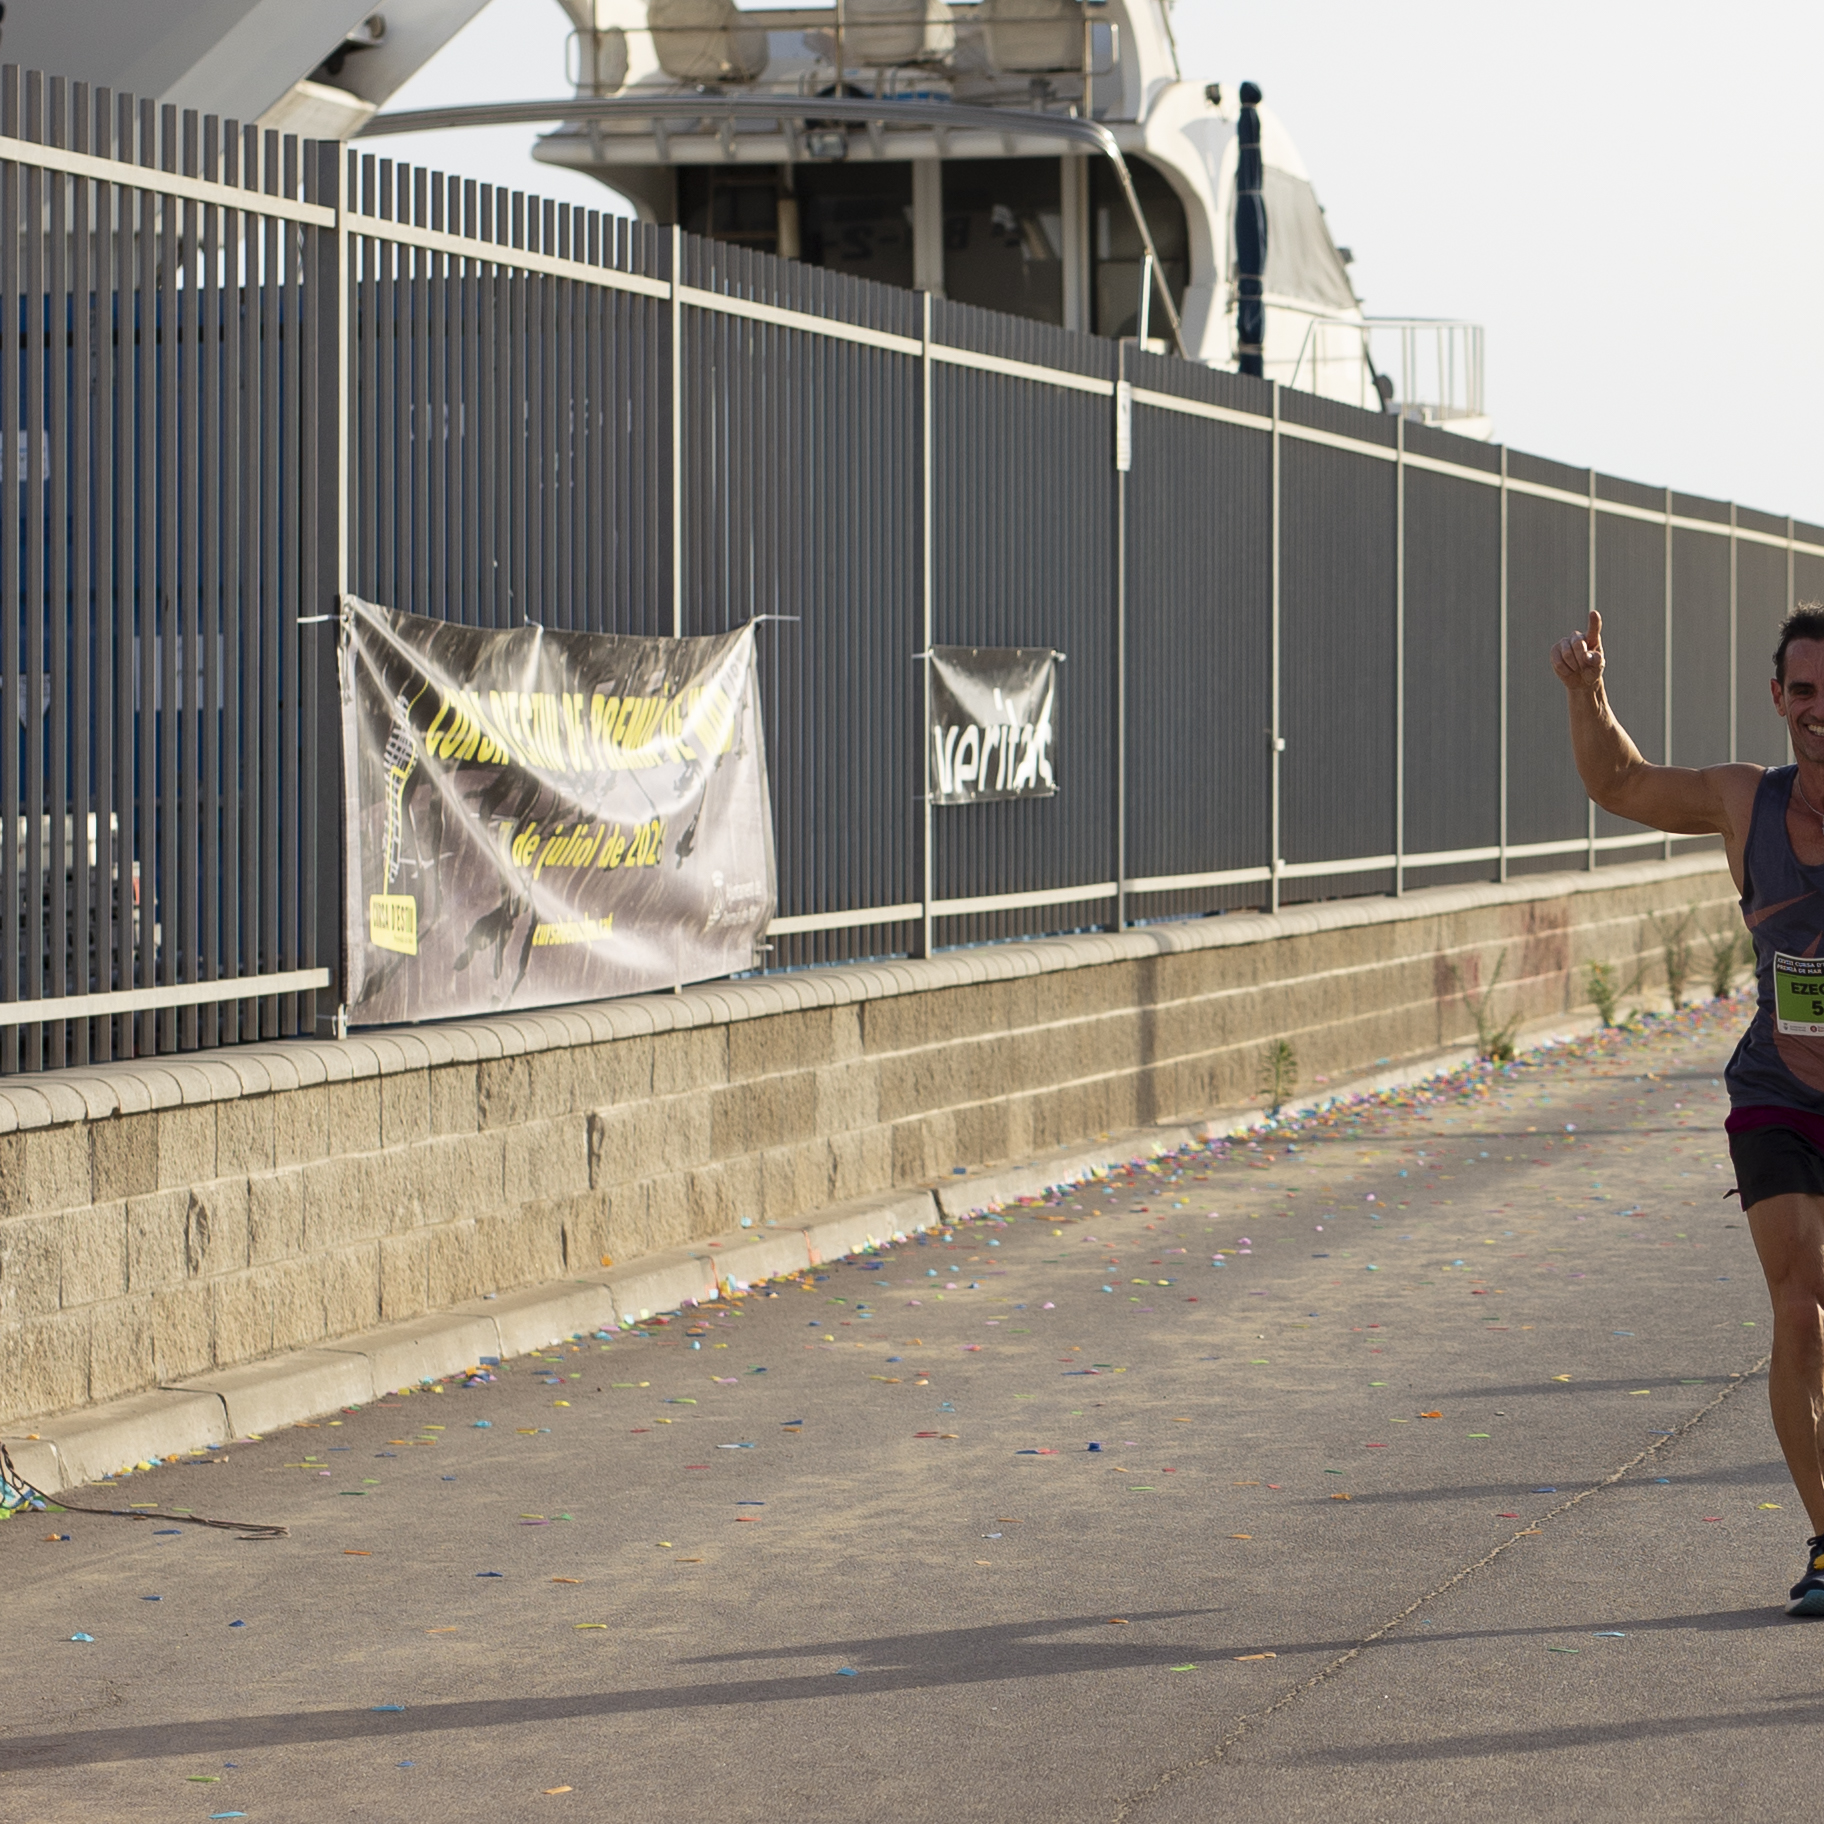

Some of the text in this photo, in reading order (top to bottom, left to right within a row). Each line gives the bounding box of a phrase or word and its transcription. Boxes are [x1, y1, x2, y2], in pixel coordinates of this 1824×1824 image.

[562, 692, 593, 772] DE
[511, 821, 541, 868] de
[532, 823, 606, 881] juliol
[597, 822, 626, 869] de
